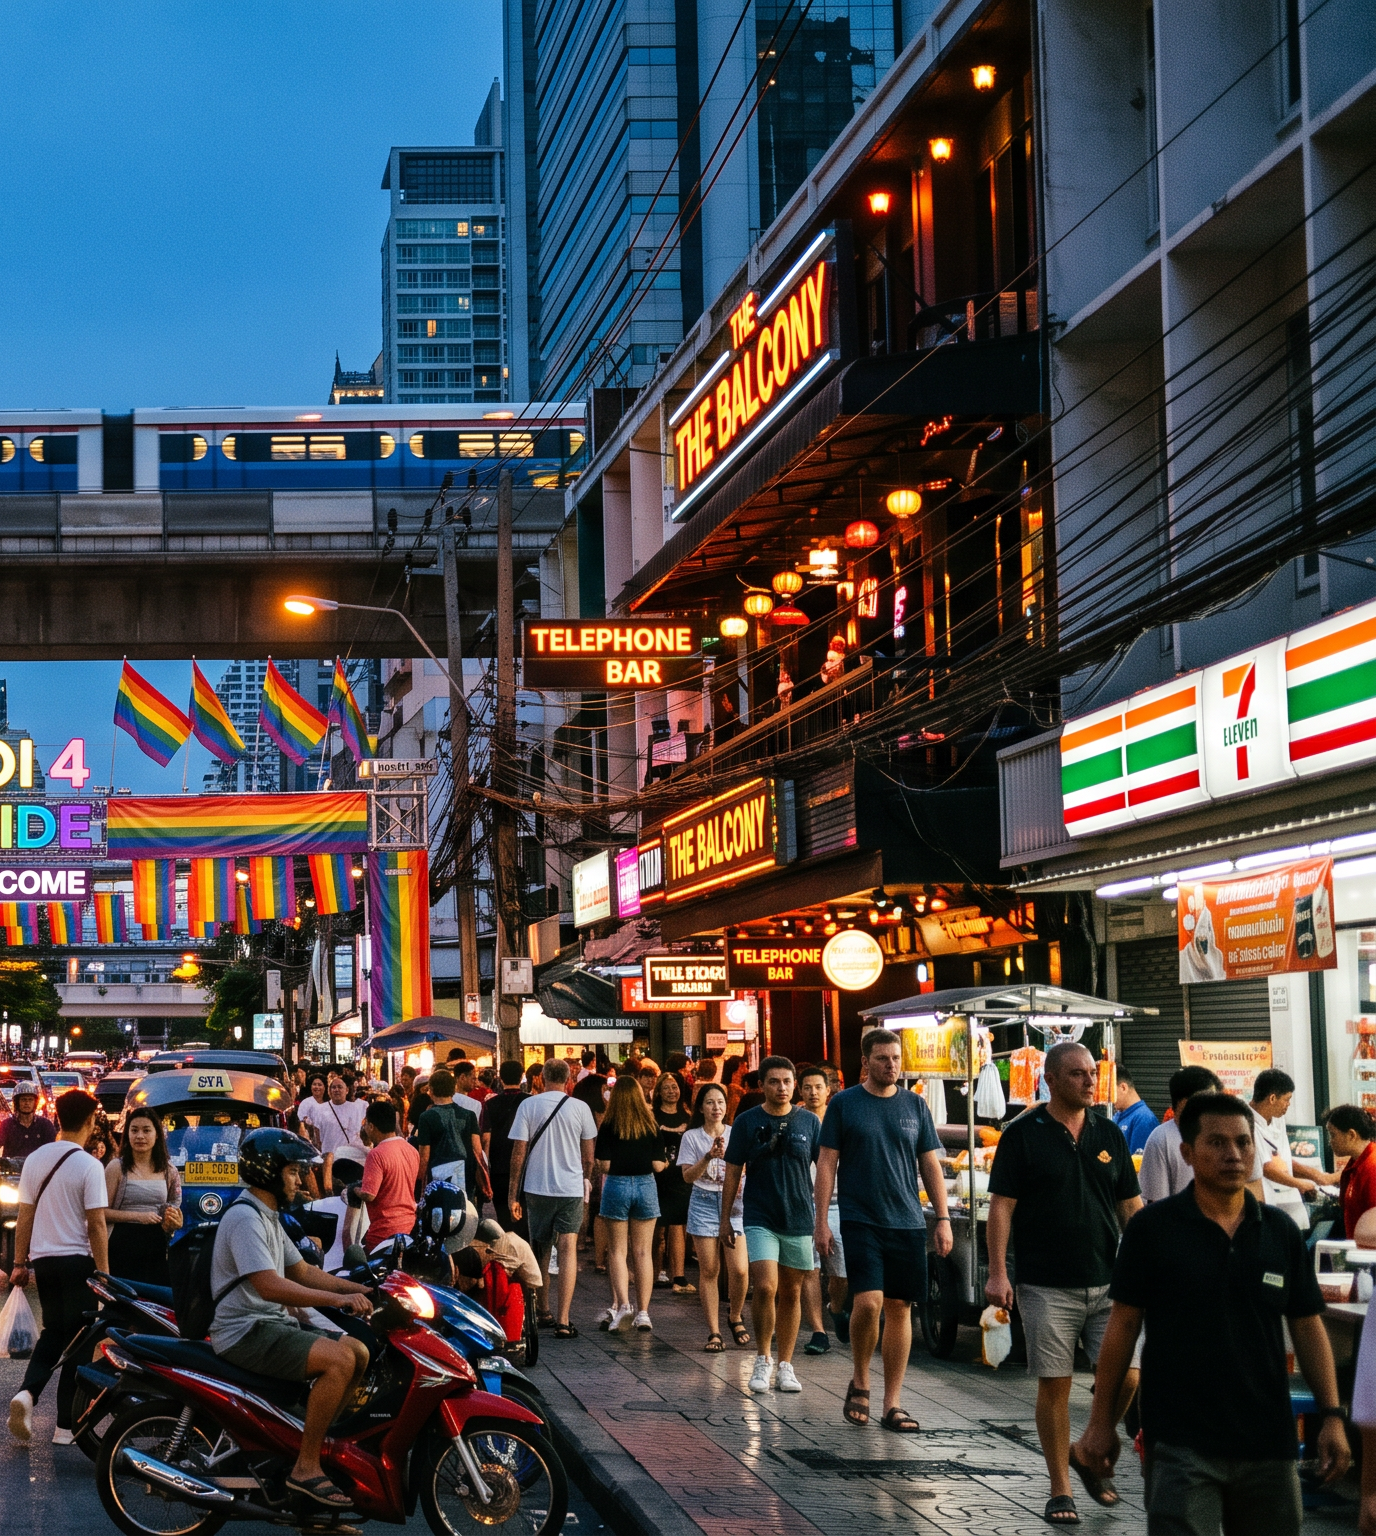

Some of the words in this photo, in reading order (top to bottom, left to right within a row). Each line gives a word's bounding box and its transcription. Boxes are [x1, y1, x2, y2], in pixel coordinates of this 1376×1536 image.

[729, 291, 756, 350] THE
[675, 396, 714, 491] THE
[715, 260, 826, 451] BALCONY
[530, 627, 692, 652] TELEPHONE
[606, 659, 662, 684] BAR
[48, 737, 91, 789] 4
[669, 827, 696, 881] THE
[696, 794, 766, 872] BALCONY
[732, 948, 822, 964] TELEPHONE
[767, 966, 794, 981] BAR
